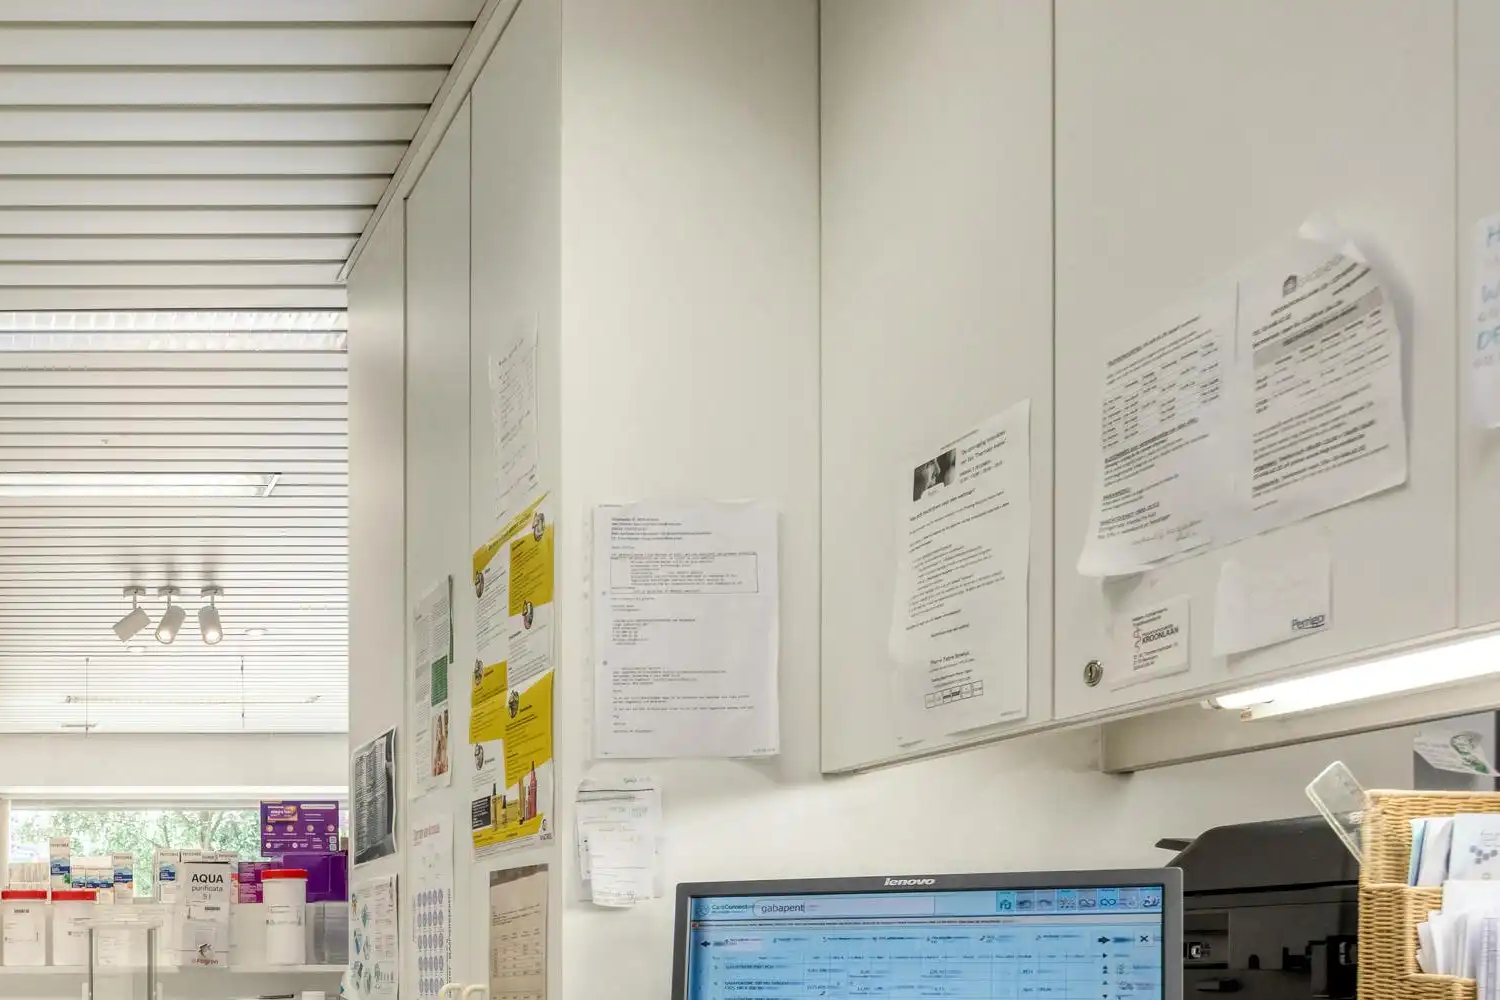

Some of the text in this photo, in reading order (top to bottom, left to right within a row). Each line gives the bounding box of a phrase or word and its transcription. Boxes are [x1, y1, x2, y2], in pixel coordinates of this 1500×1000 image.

[1291, 614, 1325, 630] Perrigo
[191, 873, 224, 883] AQUA
[884, 877, 935, 886] lenovo
[761, 903, 804, 913] gabapent
